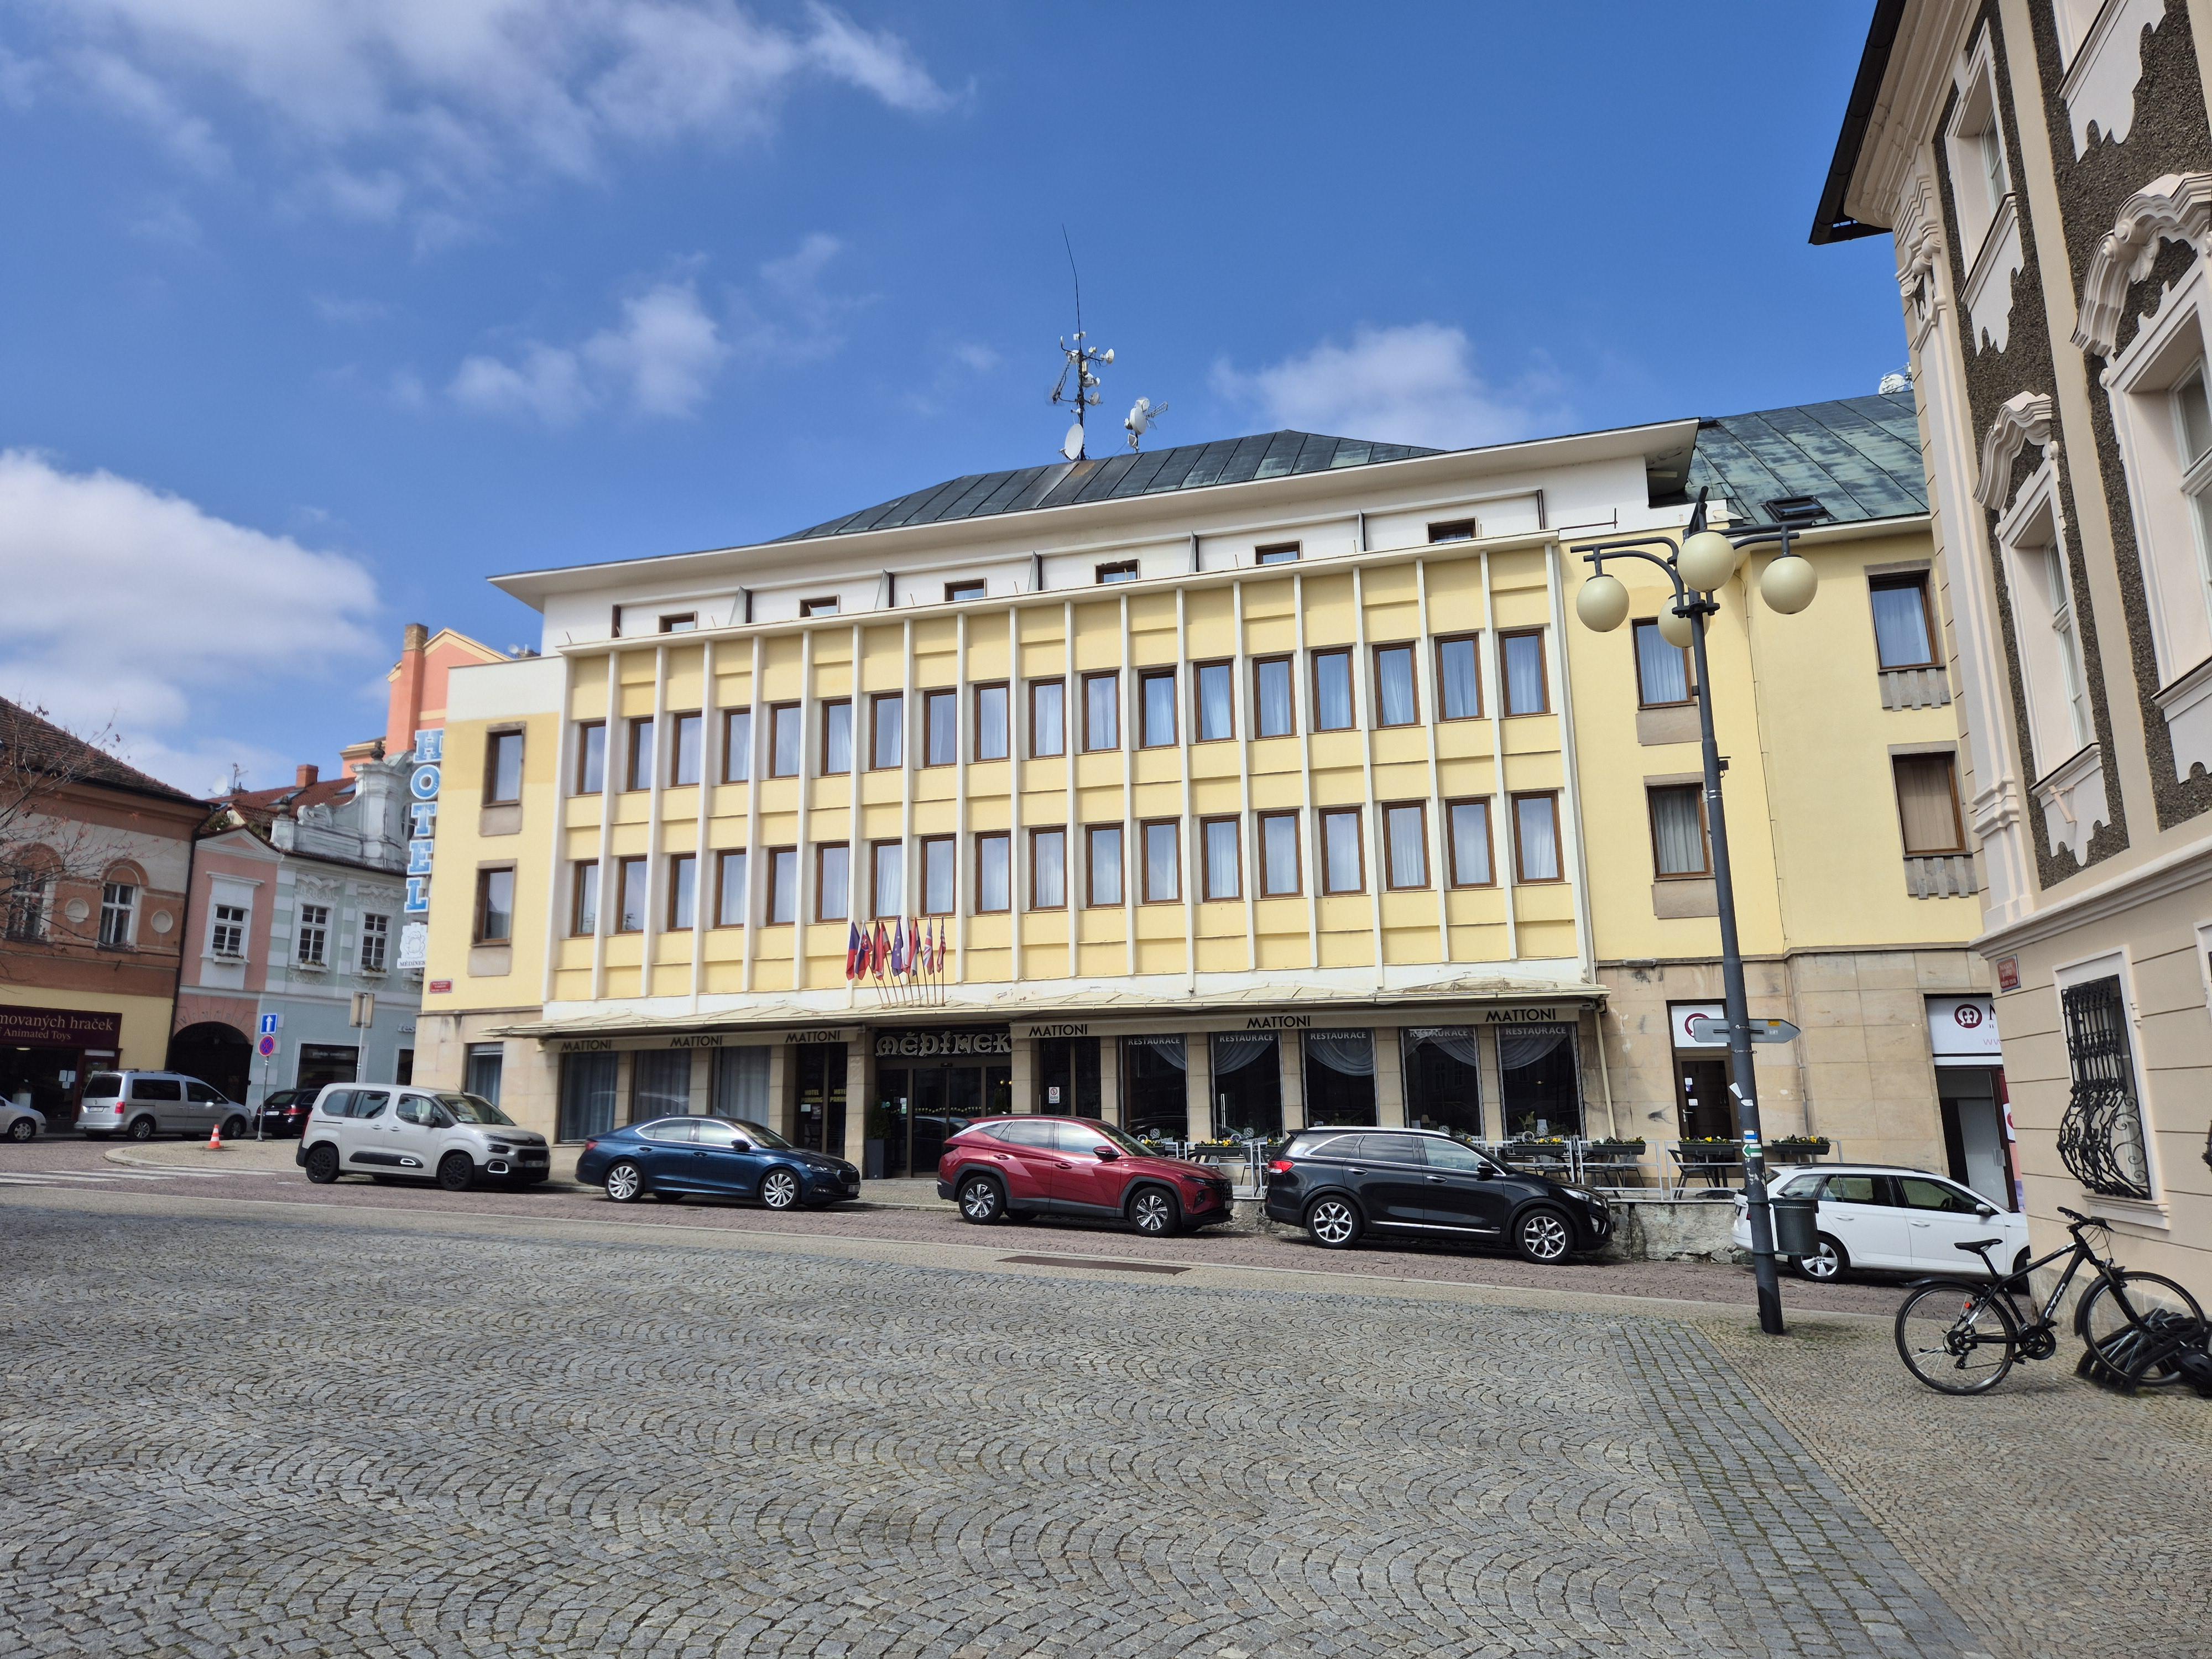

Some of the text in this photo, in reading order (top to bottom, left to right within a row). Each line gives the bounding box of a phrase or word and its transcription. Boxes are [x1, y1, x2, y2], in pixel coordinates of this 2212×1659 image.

[404, 728, 445, 913] HOTEL
[1485, 1008, 1557, 1022] MATTONI
[70, 1016, 113, 1031] hraček
[1246, 1015, 1311, 1029] MATTONI
[3, 1028, 71, 1042] Animated Toys
[785, 1030, 841, 1043] MATTONI
[1029, 1024, 1088, 1037] MATTONI
[1310, 1031, 1367, 1040] RESTAURACE
[1410, 1029, 1468, 1037] RESTAURACE
[1505, 1026, 1567, 1035] RESTAURACE
[561, 1039, 612, 1051] MATTONI
[669, 1035, 723, 1047] MATTONI
[1128, 1037, 1181, 1045] RESTAURACE
